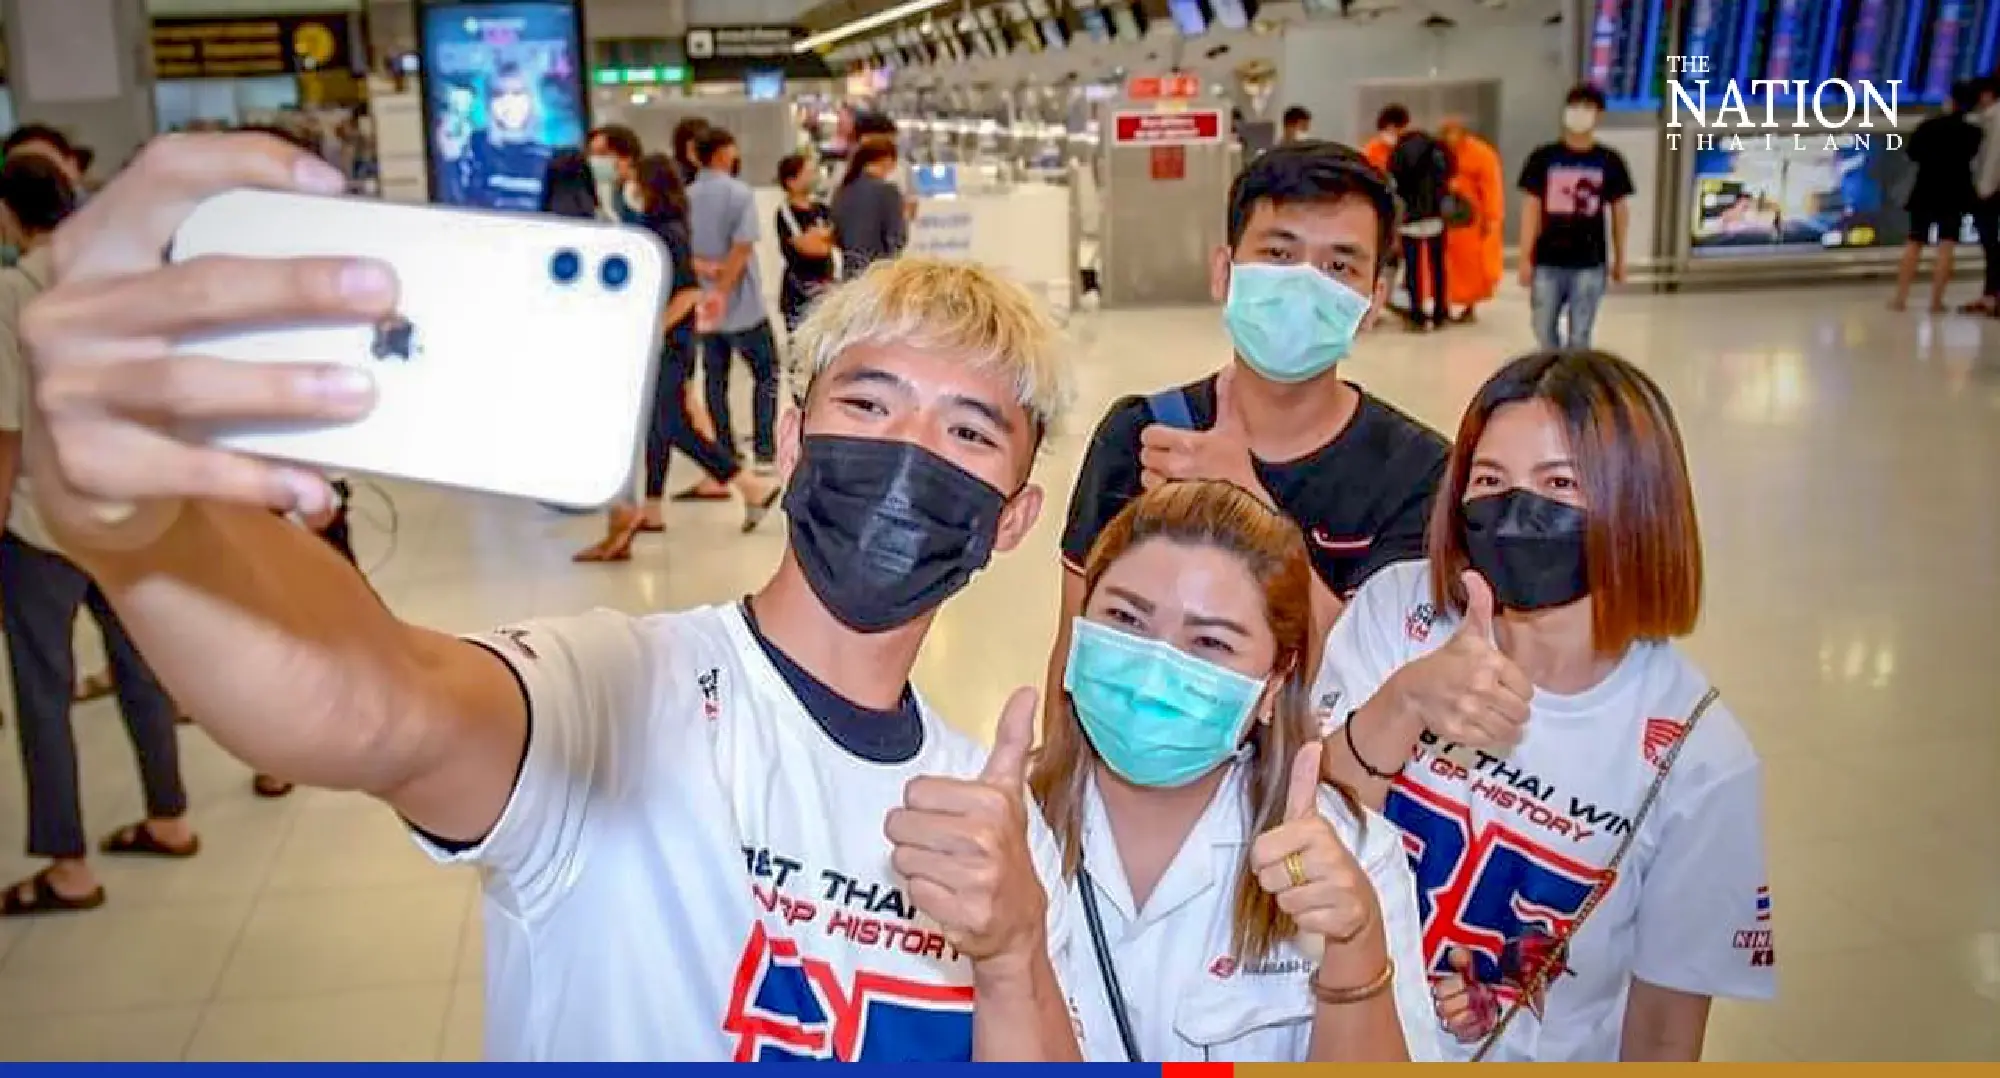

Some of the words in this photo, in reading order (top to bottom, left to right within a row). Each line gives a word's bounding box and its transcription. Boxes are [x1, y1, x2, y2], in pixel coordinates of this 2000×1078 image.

[1429, 756, 1469, 781] GP
[1470, 779, 1596, 843] HISTORY
[1475, 750, 1555, 801] THAI
